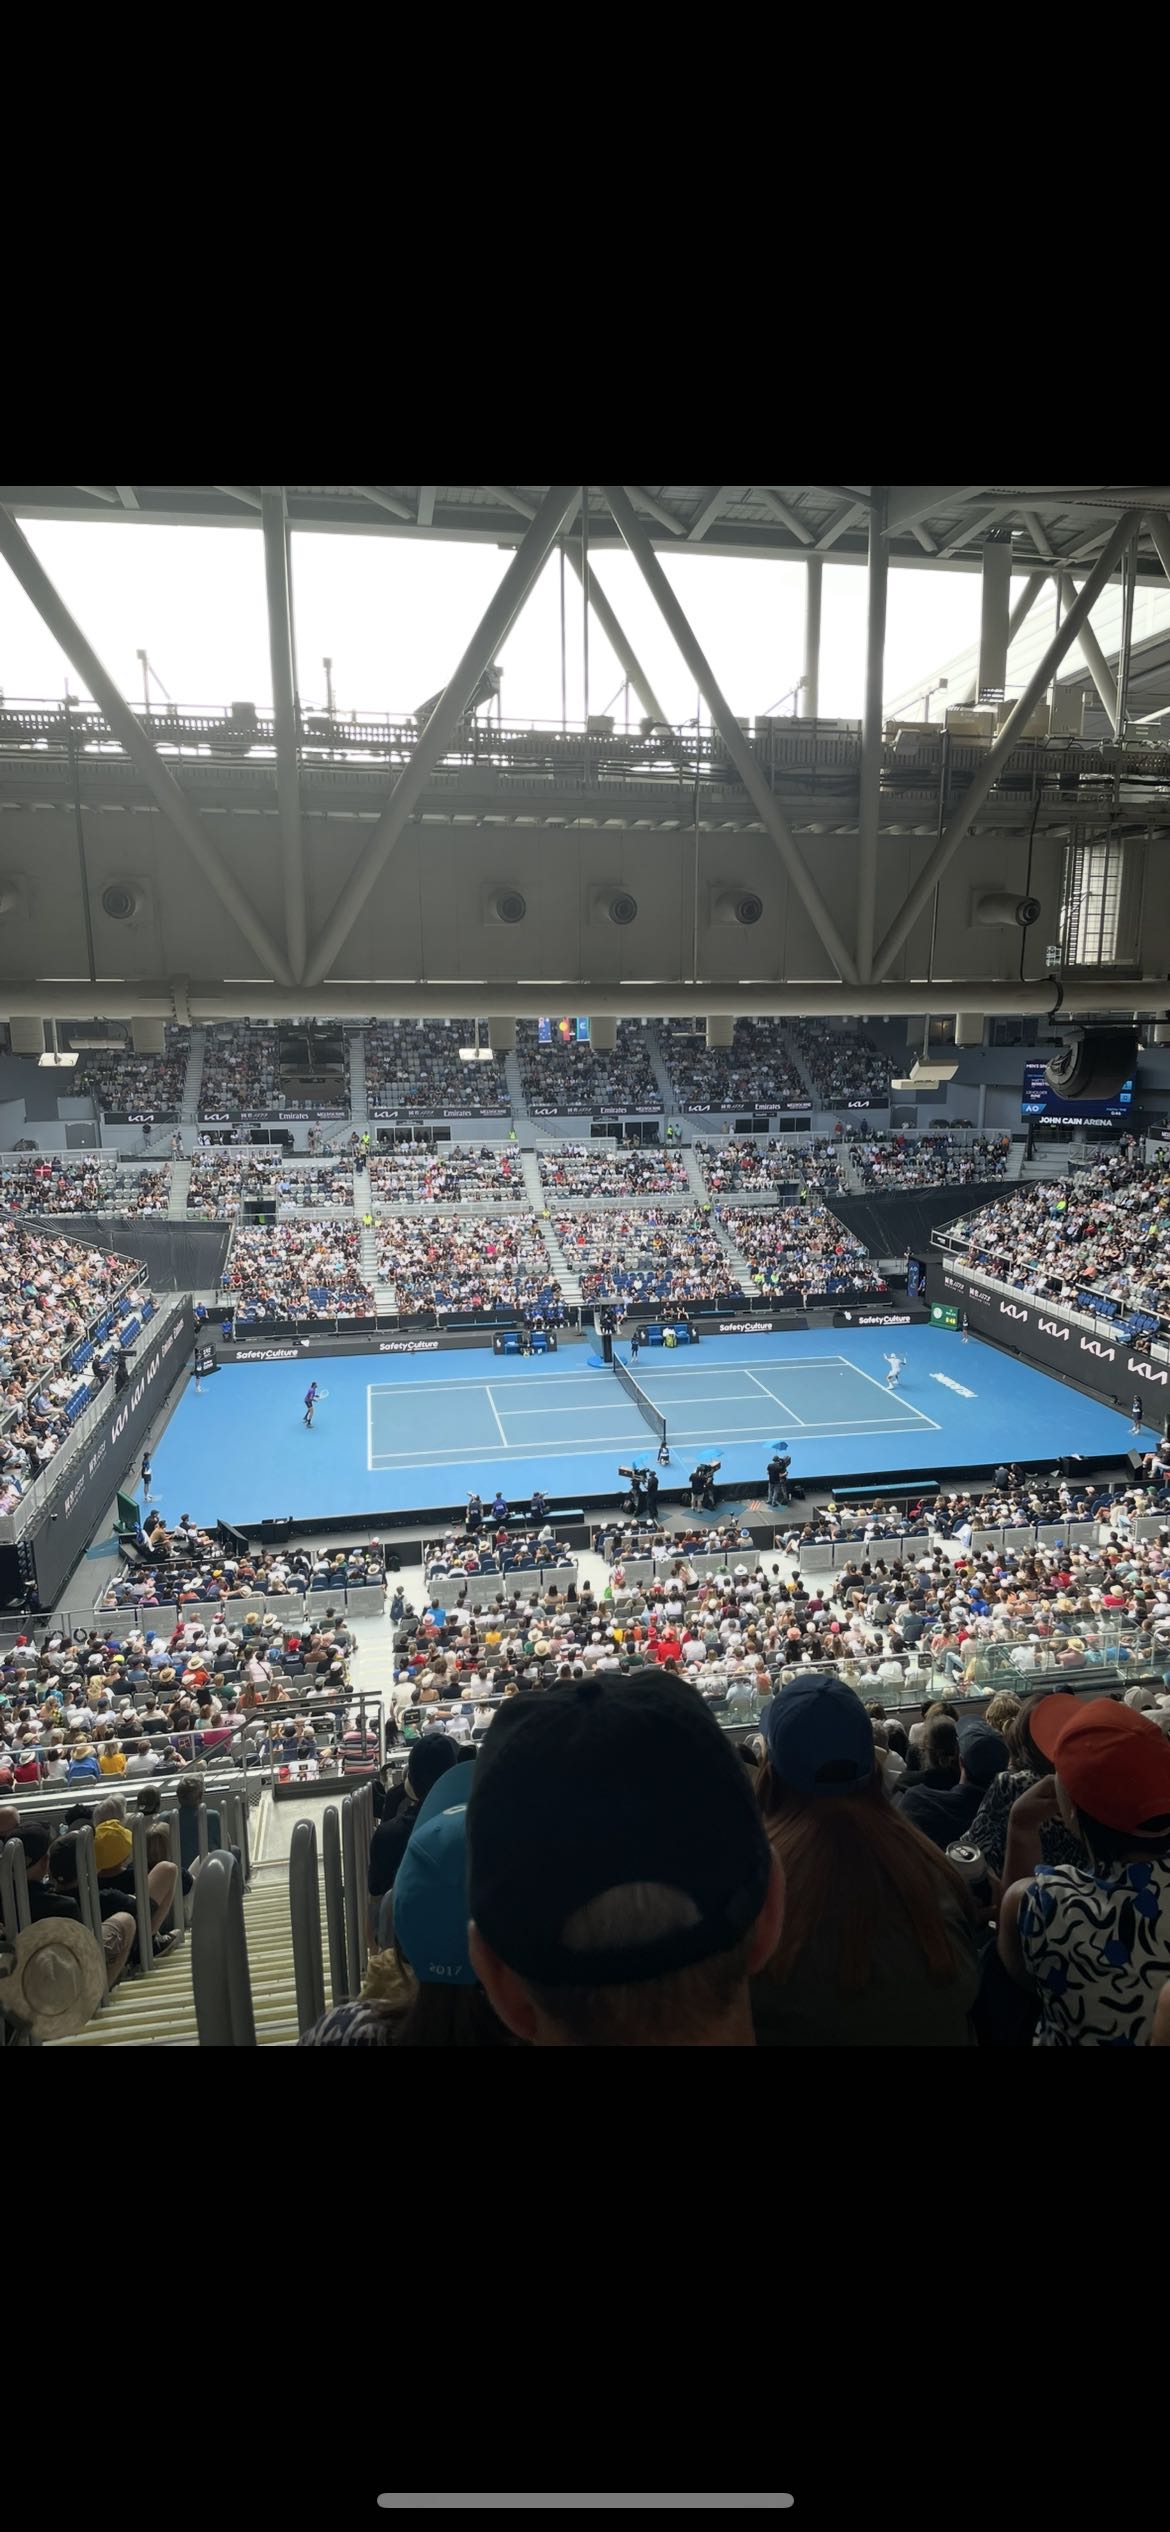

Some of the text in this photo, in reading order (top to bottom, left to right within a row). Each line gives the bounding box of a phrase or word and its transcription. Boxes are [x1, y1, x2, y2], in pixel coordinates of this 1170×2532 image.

[128, 1114, 154, 1122] KIA
[279, 1112, 309, 1120] Emirates
[1039, 1116, 1112, 1127] JOHN CAIN ARENA
[858, 1314, 911, 1325] SafetyCulture
[719, 1322, 773, 1332] SafetyCulture
[379, 1340, 439, 1351] SafetyCulture
[1000, 1301, 1168, 1385] KIA KIA KIA KIA
[236, 1349, 298, 1361] SafetyCulture
